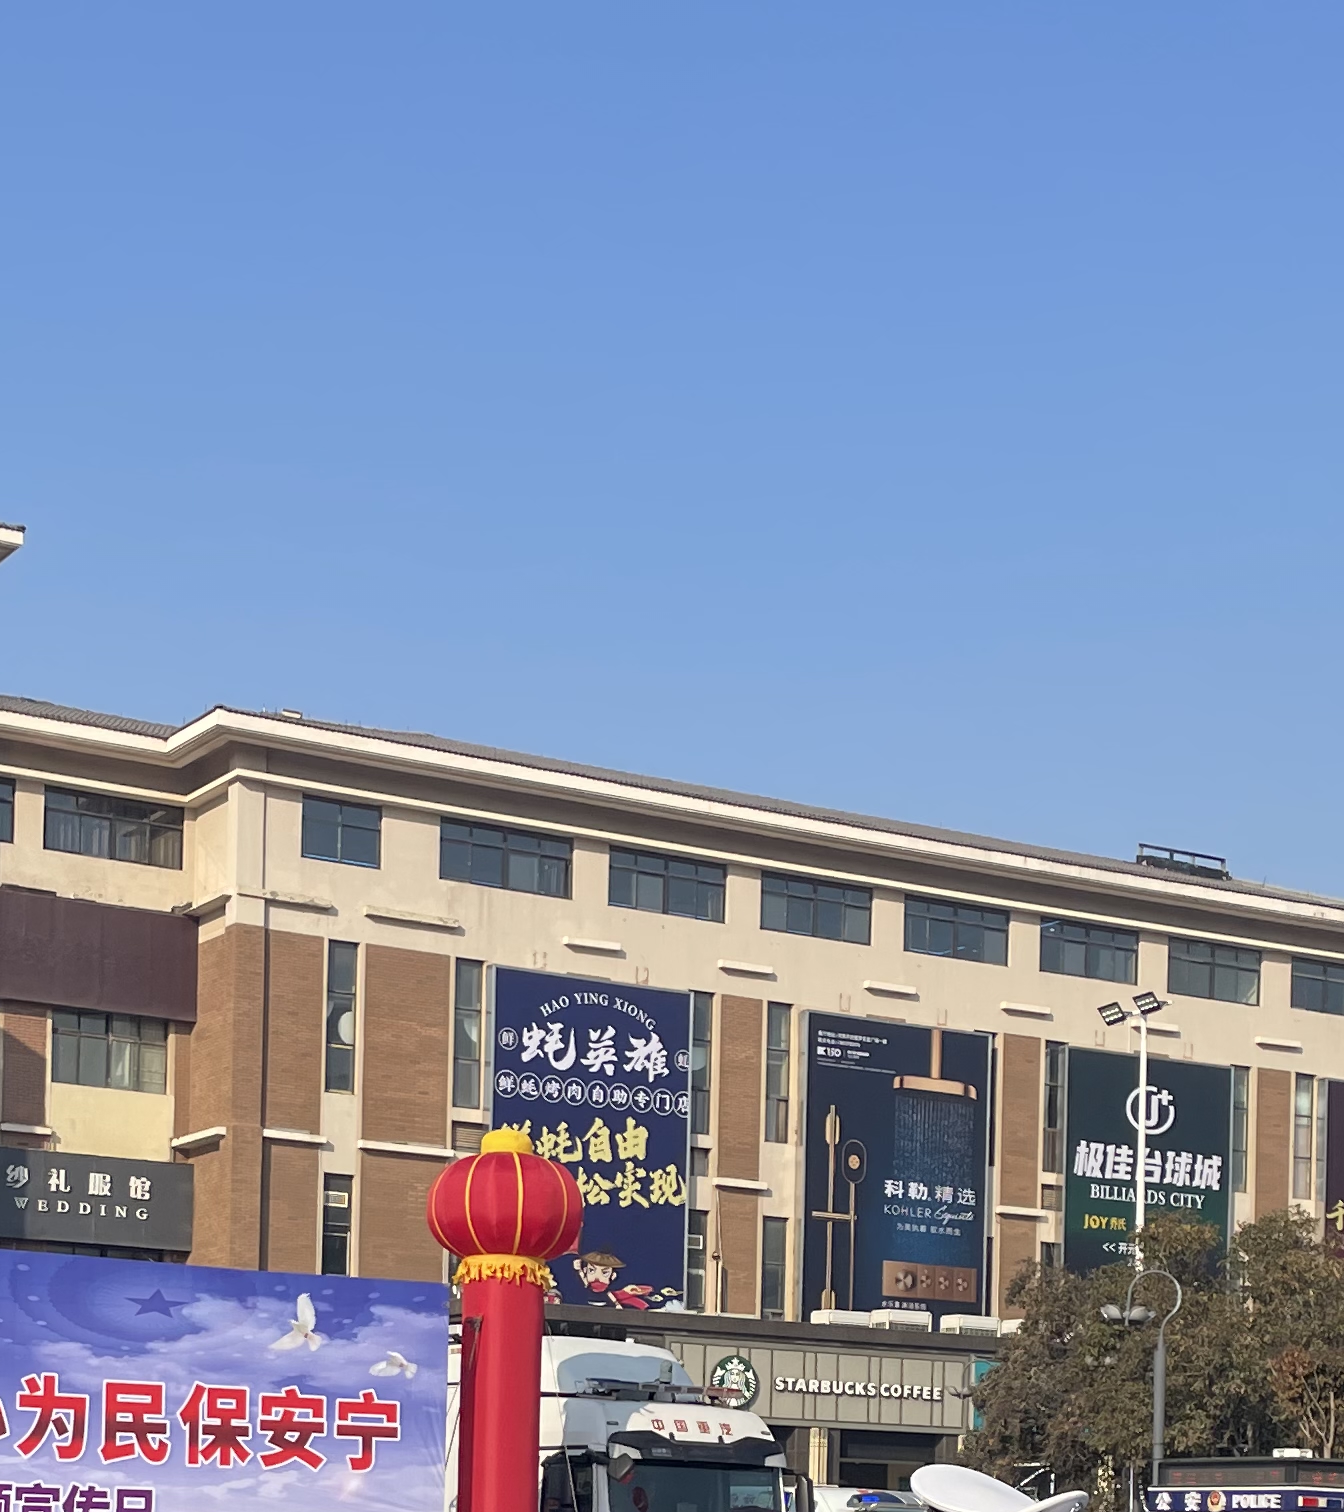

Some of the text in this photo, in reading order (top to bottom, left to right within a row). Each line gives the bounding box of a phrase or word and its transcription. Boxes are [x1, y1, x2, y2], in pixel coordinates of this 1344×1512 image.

[539, 992, 656, 1031] HAO YING XIONG
[521, 1021, 670, 1083] 蚝英雄
[1073, 1139, 1223, 1191] 极佳台球城
[14, 1196, 149, 1221] WEDDING
[1090, 1183, 1205, 1209] BILLIADS CITY
[883, 1204, 932, 1219] KOHLER
[1083, 1213, 1108, 1229] JOY
[775, 1376, 943, 1401] STARBUCKS COFFEE
[651, 1418, 733, 1437] 中国重汽
[1155, 1491, 1282, 1511] 公安 POLICE
